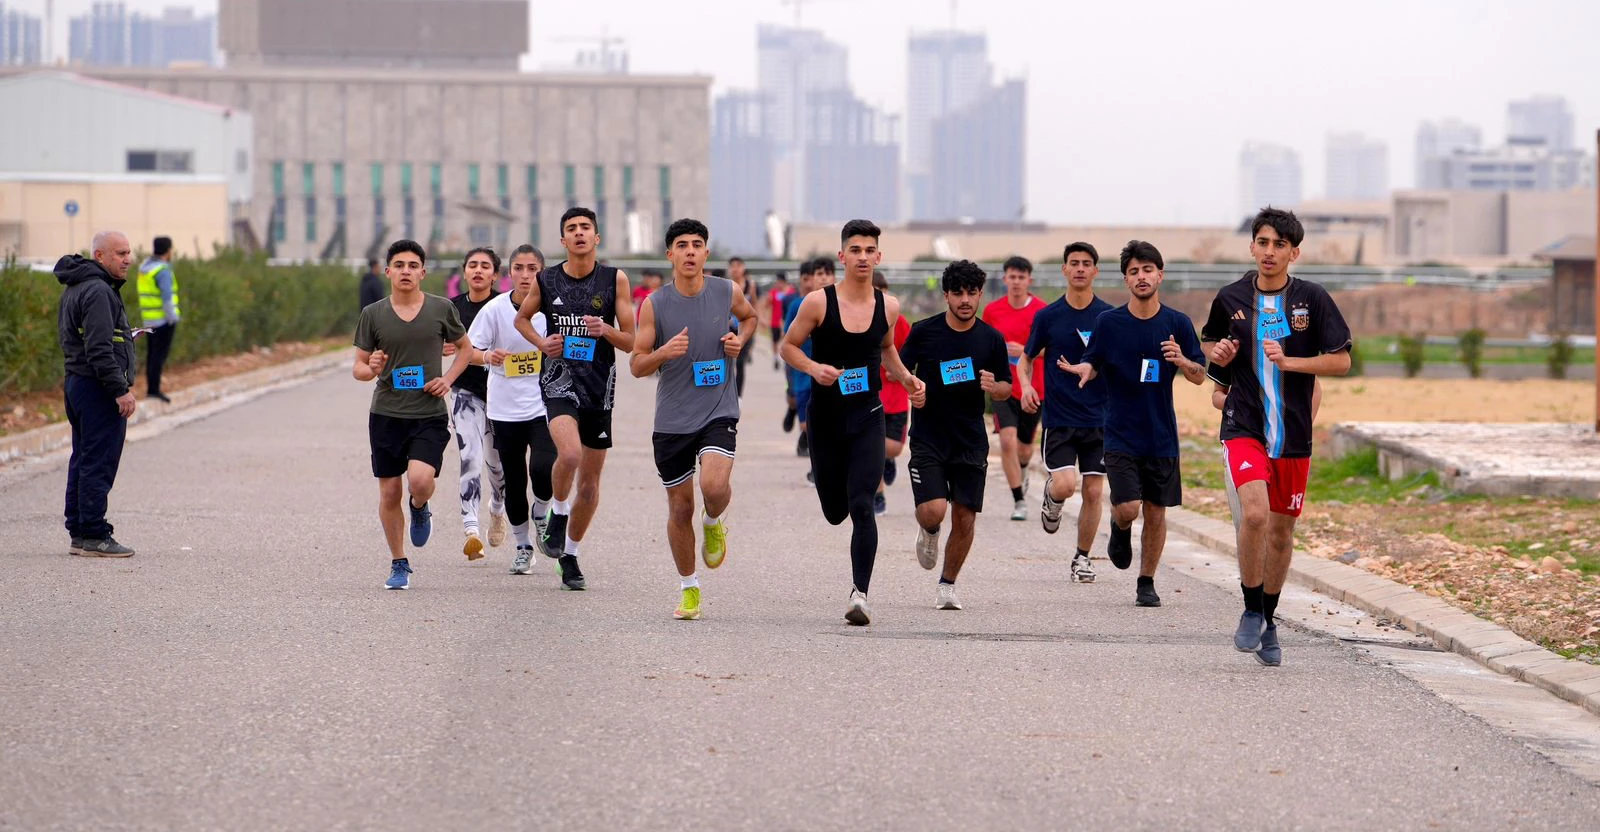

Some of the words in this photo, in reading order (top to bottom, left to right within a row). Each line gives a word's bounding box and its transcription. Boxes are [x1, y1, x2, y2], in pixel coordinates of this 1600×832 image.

[559, 327, 570, 336] FLY
[572, 327, 591, 336] BETT
[1264, 328, 1284, 339] 480
[511, 352, 538, 364] شابات
[569, 350, 588, 360] 462
[518, 364, 535, 375] 55
[702, 374, 720, 384] 459
[950, 371, 968, 382] 486
[399, 378, 418, 388] 456
[845, 382, 863, 392] 458
[1287, 492, 1304, 509] 18
